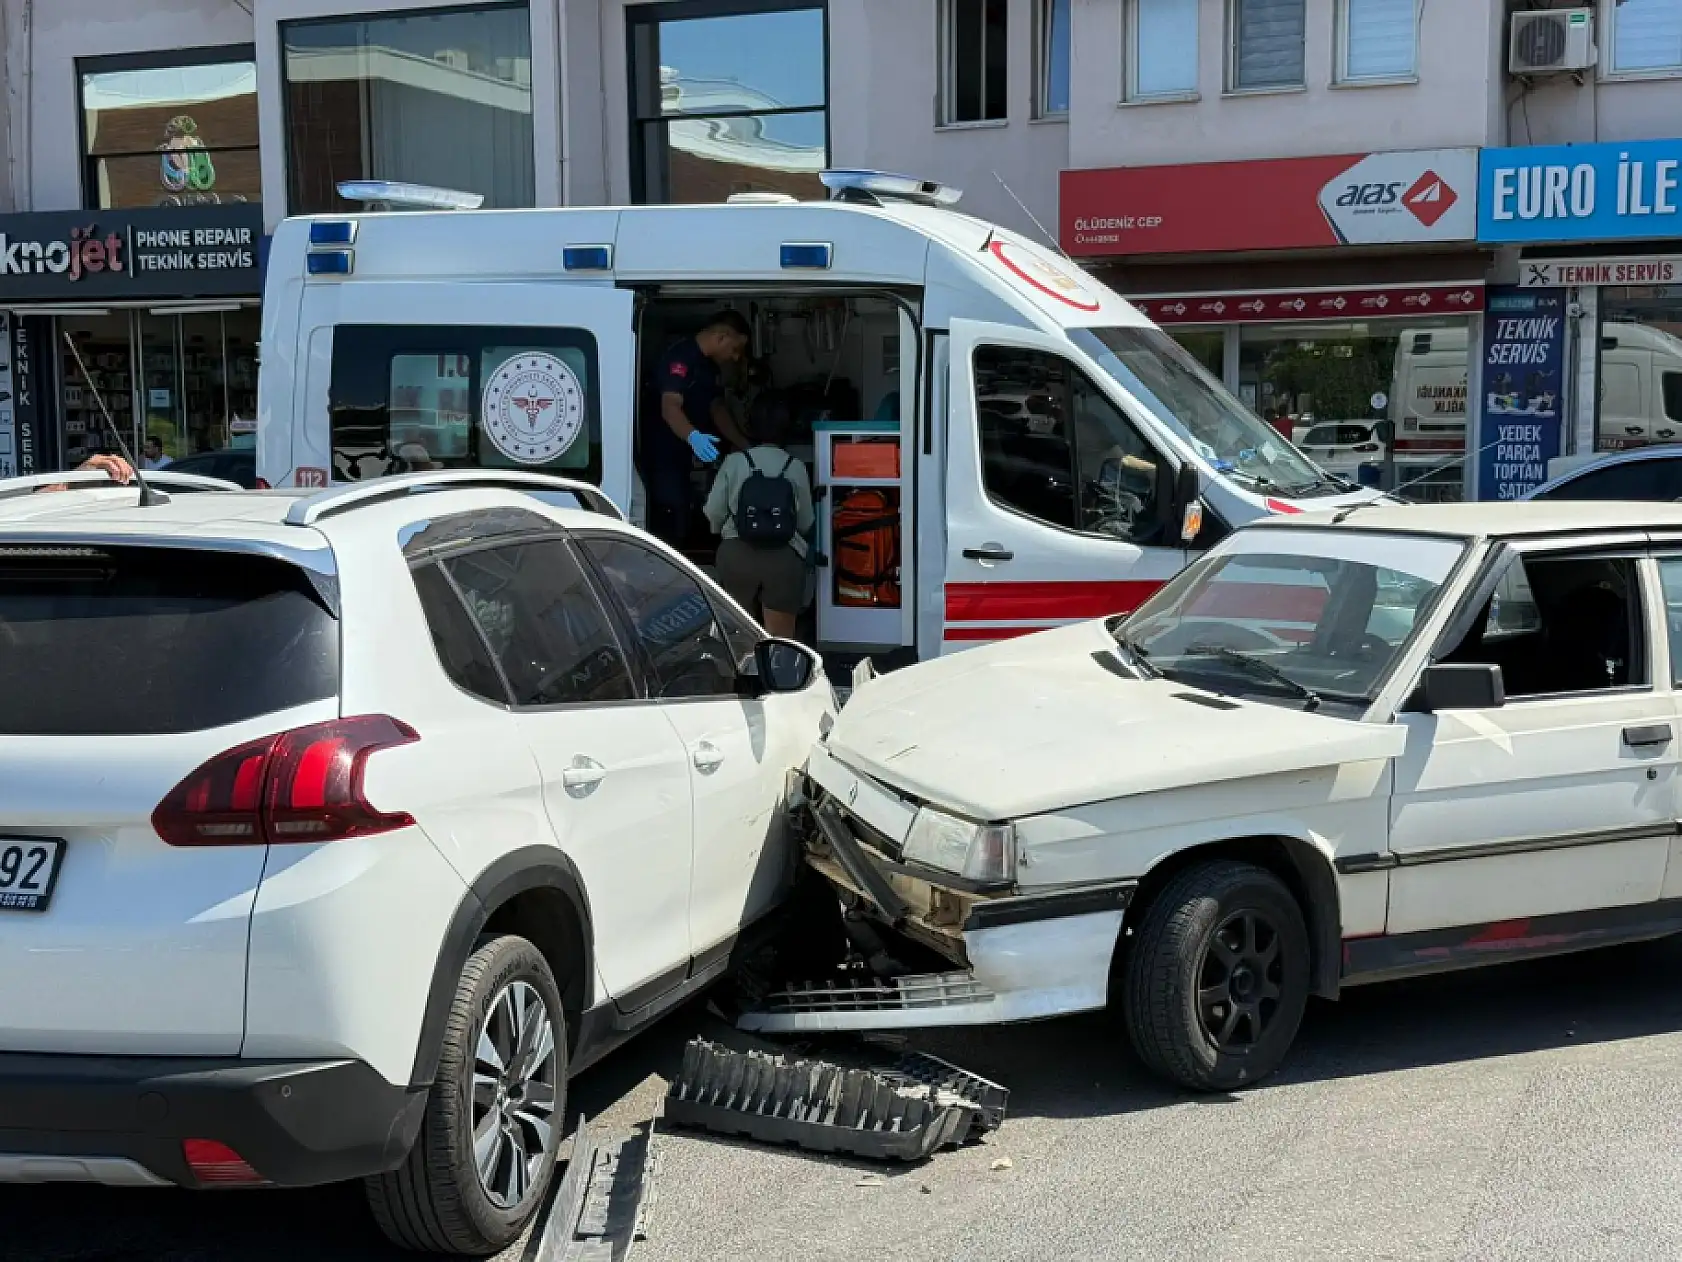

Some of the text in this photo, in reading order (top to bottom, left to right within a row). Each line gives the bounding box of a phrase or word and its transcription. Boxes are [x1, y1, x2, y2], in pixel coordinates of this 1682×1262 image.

[1335, 182, 1402, 207] aras
[1493, 151, 1678, 221] EURO İLE
[1074, 214, 1163, 231] ÖLÜDENİZ CEP
[137, 227, 251, 248] PHONE REPAIR
[138, 247, 253, 270] TEKNİK SERVİS
[1557, 260, 1674, 283] TEKNİK SERVİS
[1495, 315, 1559, 340] TEKNİK
[1488, 340, 1550, 365] SERVİS
[1497, 425, 1543, 442] YEDEK
[1497, 444, 1540, 464] PARÇA
[299, 470, 323, 488] 112
[1492, 463, 1544, 480] TOPTAN
